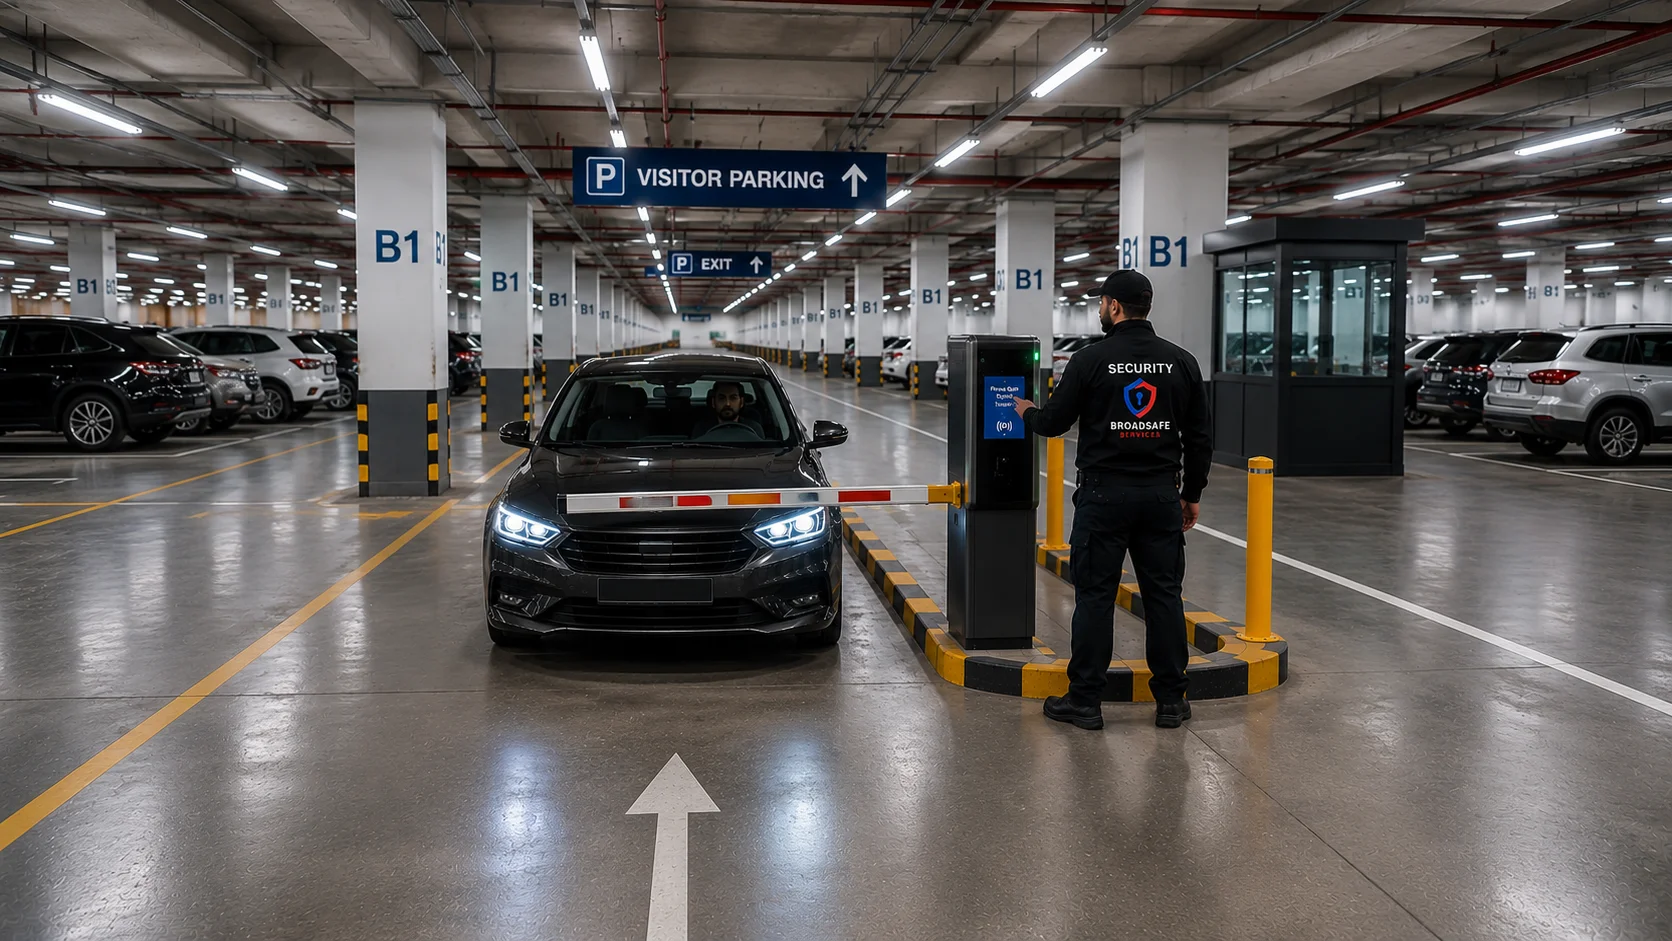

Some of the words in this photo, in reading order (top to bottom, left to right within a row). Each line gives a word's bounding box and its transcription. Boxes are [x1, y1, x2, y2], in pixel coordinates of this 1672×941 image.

[596, 163, 616, 189] P
[637, 168, 722, 187] VISITOR
[730, 170, 824, 189] PARKING
[376, 229, 418, 263] B1
[436, 231, 445, 266] B1
[1123, 236, 1138, 269] B1
[1150, 236, 1187, 267] B1
[676, 257, 688, 270] P
[701, 258, 733, 270] EXIT
[77, 279, 97, 294] B1
[492, 271, 518, 292] B1
[1016, 269, 1042, 290] B1
[208, 293, 224, 304] B1
[549, 293, 567, 306] B1
[923, 289, 941, 304] B1
[581, 304, 594, 315] B1
[829, 309, 841, 318] B1
[863, 301, 878, 313] B1
[1108, 363, 1173, 374] SECURITY
[1110, 421, 1171, 430] BROADSAFE
